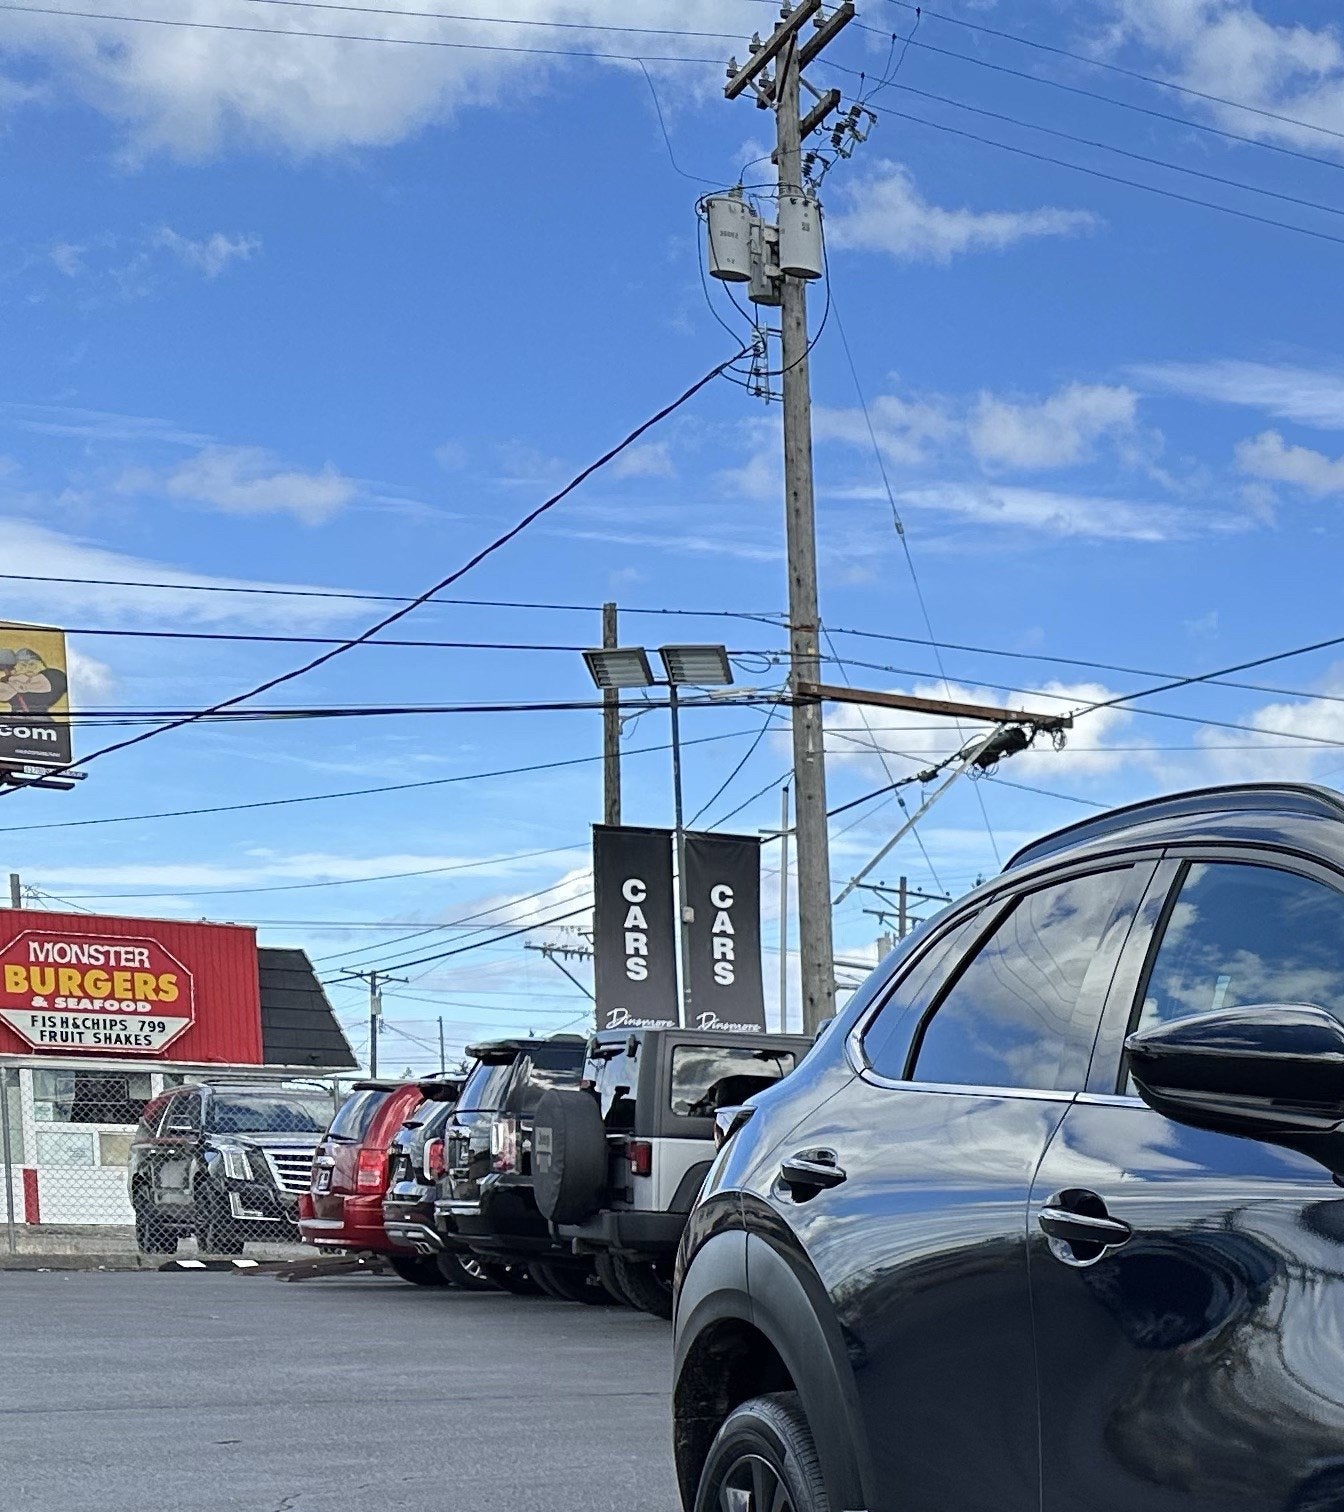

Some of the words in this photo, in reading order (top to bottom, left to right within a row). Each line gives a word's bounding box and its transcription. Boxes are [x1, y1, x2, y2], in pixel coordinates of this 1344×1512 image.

[622, 878, 649, 981] CARS
[710, 884, 735, 986] CARS
[28, 941, 150, 968] MONSTER
[4, 964, 179, 1002] BURGERS
[31, 996, 48, 1008] &
[54, 997, 152, 1012] SEAFOOD
[31, 1015, 128, 1031] FISH&CHIPS
[138, 1020, 166, 1033] 799
[606, 1007, 675, 1029] Dinsmore
[696, 1011, 762, 1032] Dinsmore
[40, 1030, 84, 1043] FRUIT
[93, 1032, 152, 1046] SHAKES
